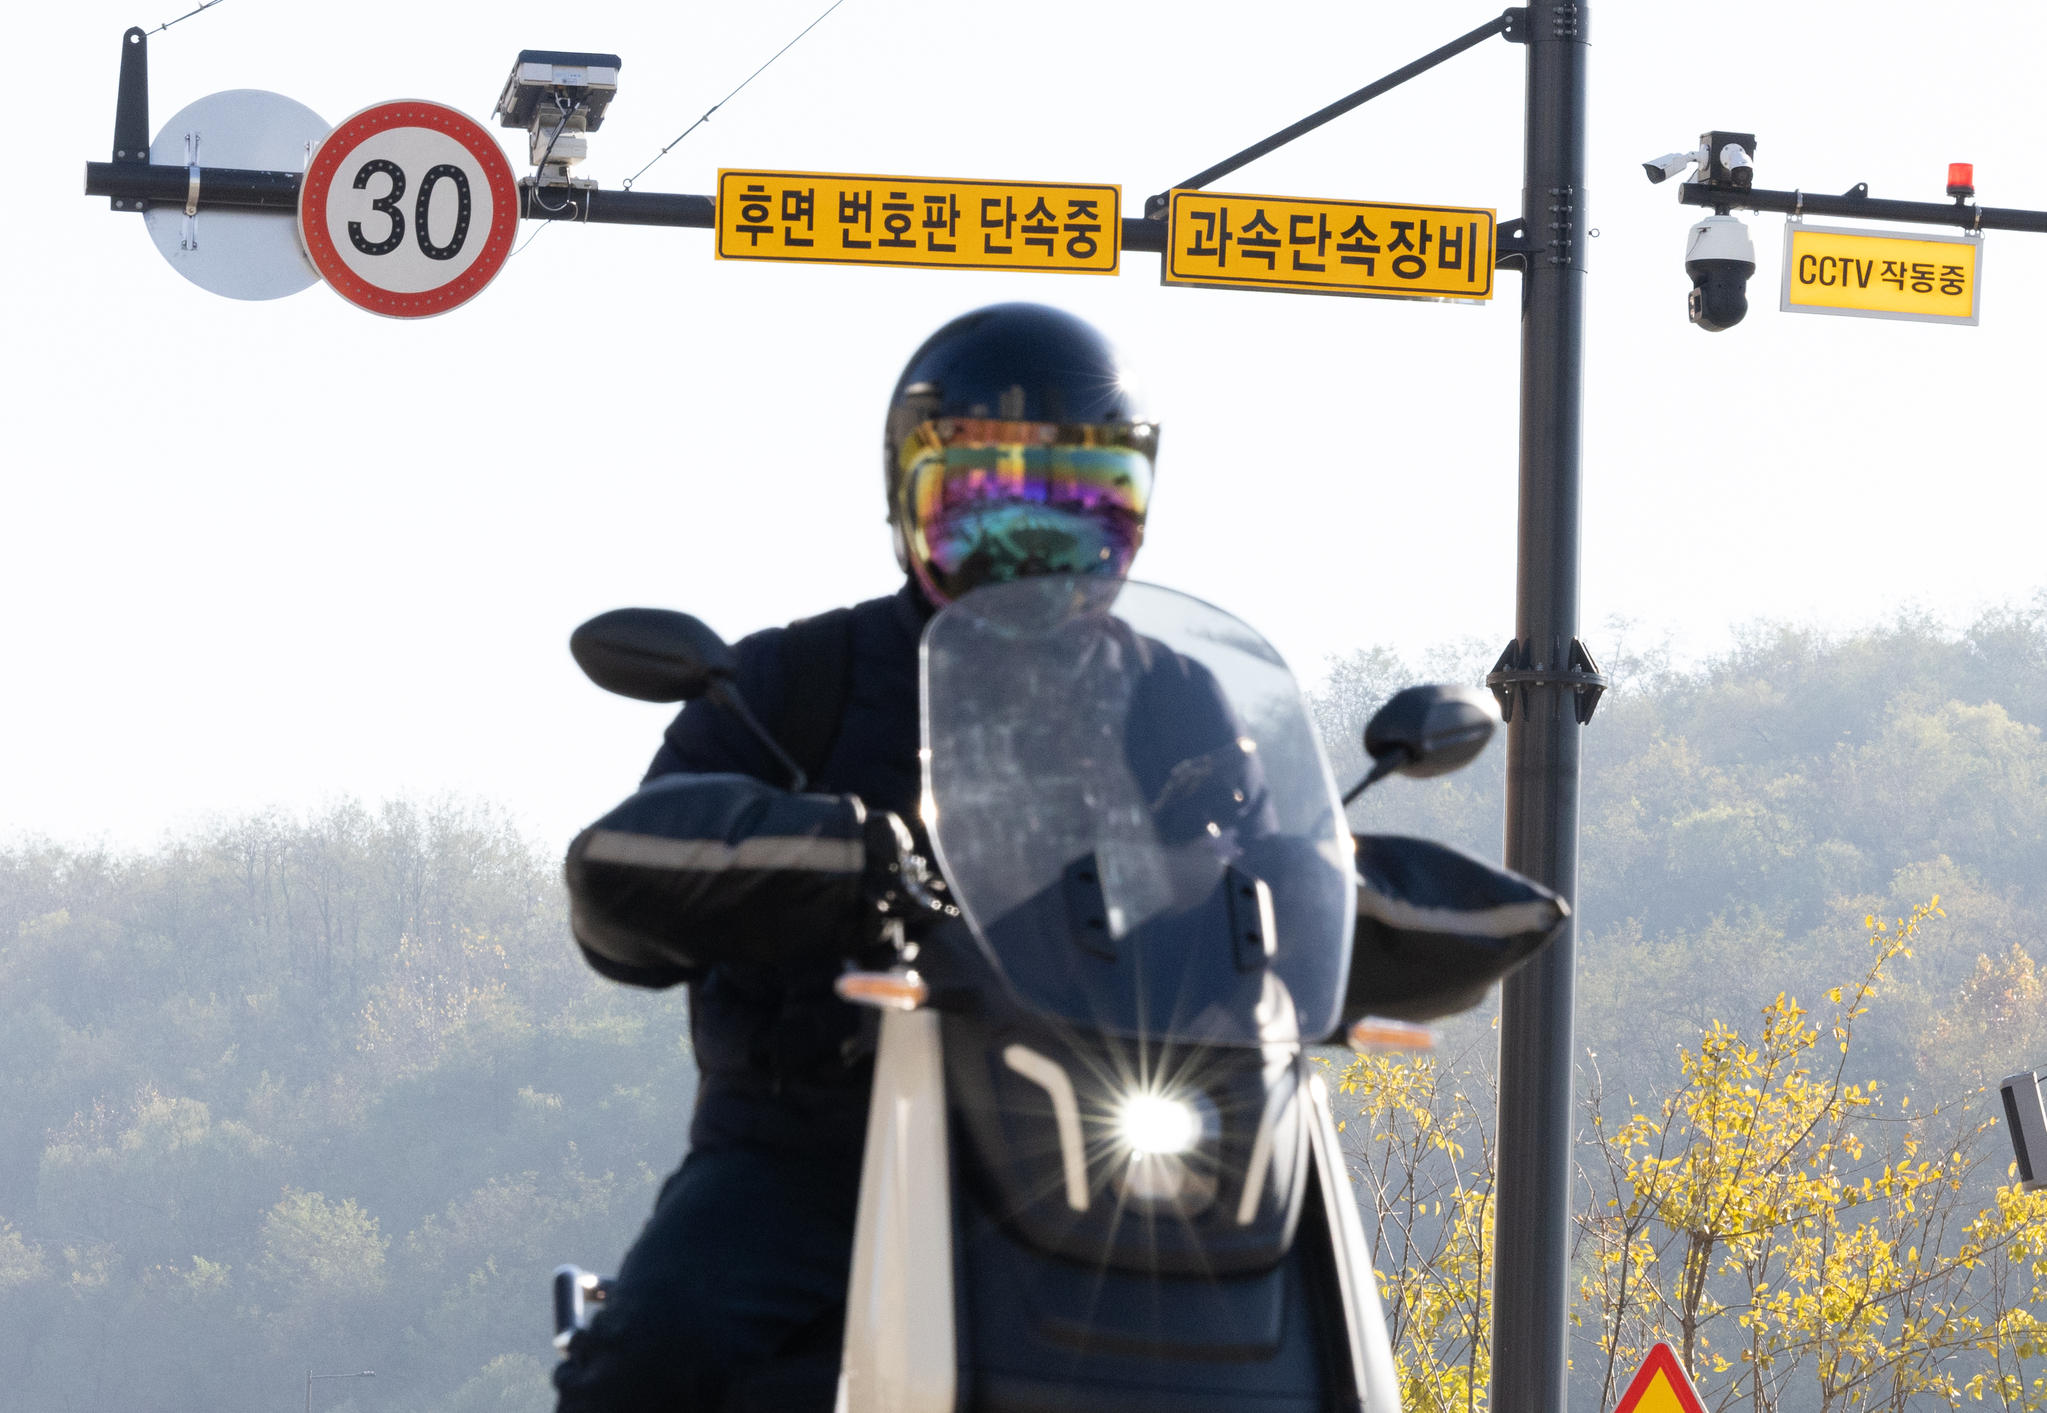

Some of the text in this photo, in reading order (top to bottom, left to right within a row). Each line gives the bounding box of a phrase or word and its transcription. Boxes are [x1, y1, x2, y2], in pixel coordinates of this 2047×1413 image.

[347, 158, 472, 261] 30
[735, 184, 1102, 259] 후면 번호판 단속중
[1186, 206, 1477, 283] 과속단속장비
[1799, 254, 1966, 296] CCTV 작동중
